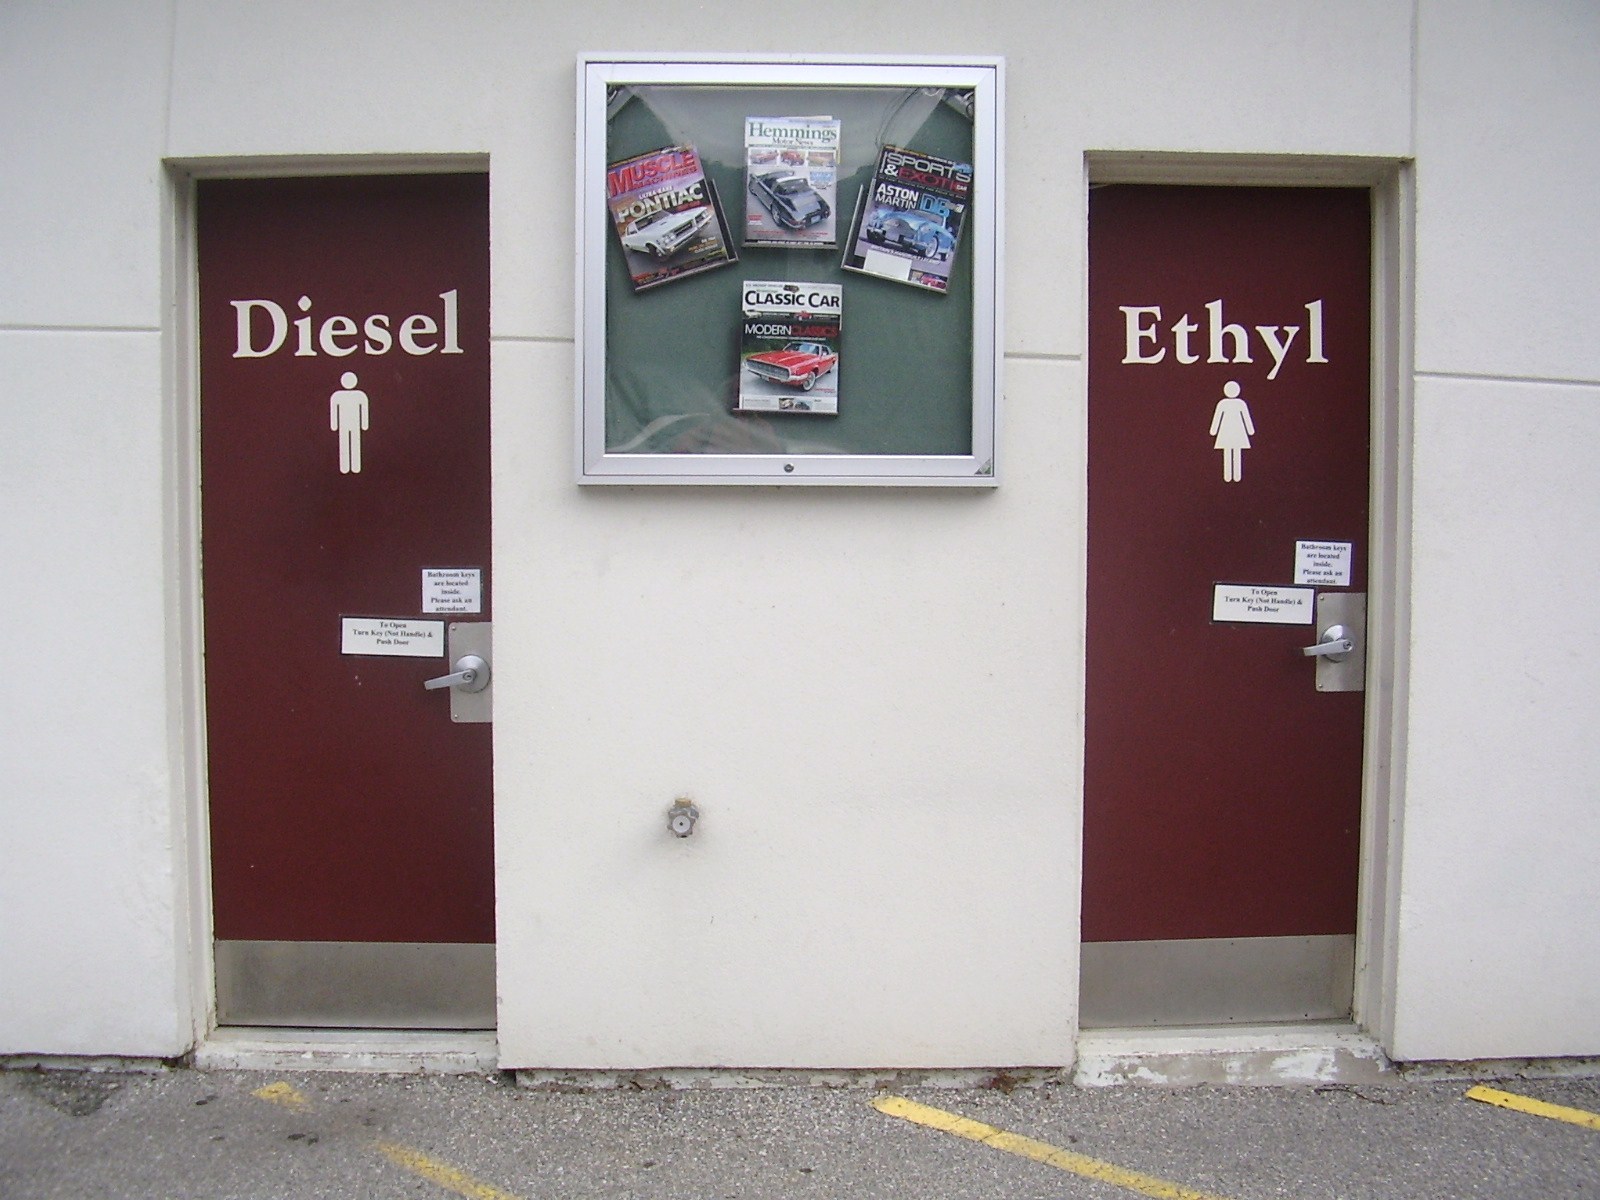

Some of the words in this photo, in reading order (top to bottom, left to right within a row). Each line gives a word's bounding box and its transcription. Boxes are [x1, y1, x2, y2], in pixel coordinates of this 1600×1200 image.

[749, 122, 837, 143] Hemmings
[608, 153, 695, 198] MUSCLE
[886, 152, 971, 183] SPORTS
[875, 194, 917, 209] MARTIN
[877, 183, 919, 202] ASTON
[617, 183, 703, 223] PONTIAC
[745, 290, 805, 305] CLASSIC
[808, 293, 840, 308] CAR
[230, 289, 464, 358] Diesel
[1119, 299, 1329, 380] Ethyl
[1242, 597, 1254, 605] Key
[1255, 597, 1270, 605] (Not
[1261, 589, 1277, 597] Open
[371, 630, 383, 638] Key
